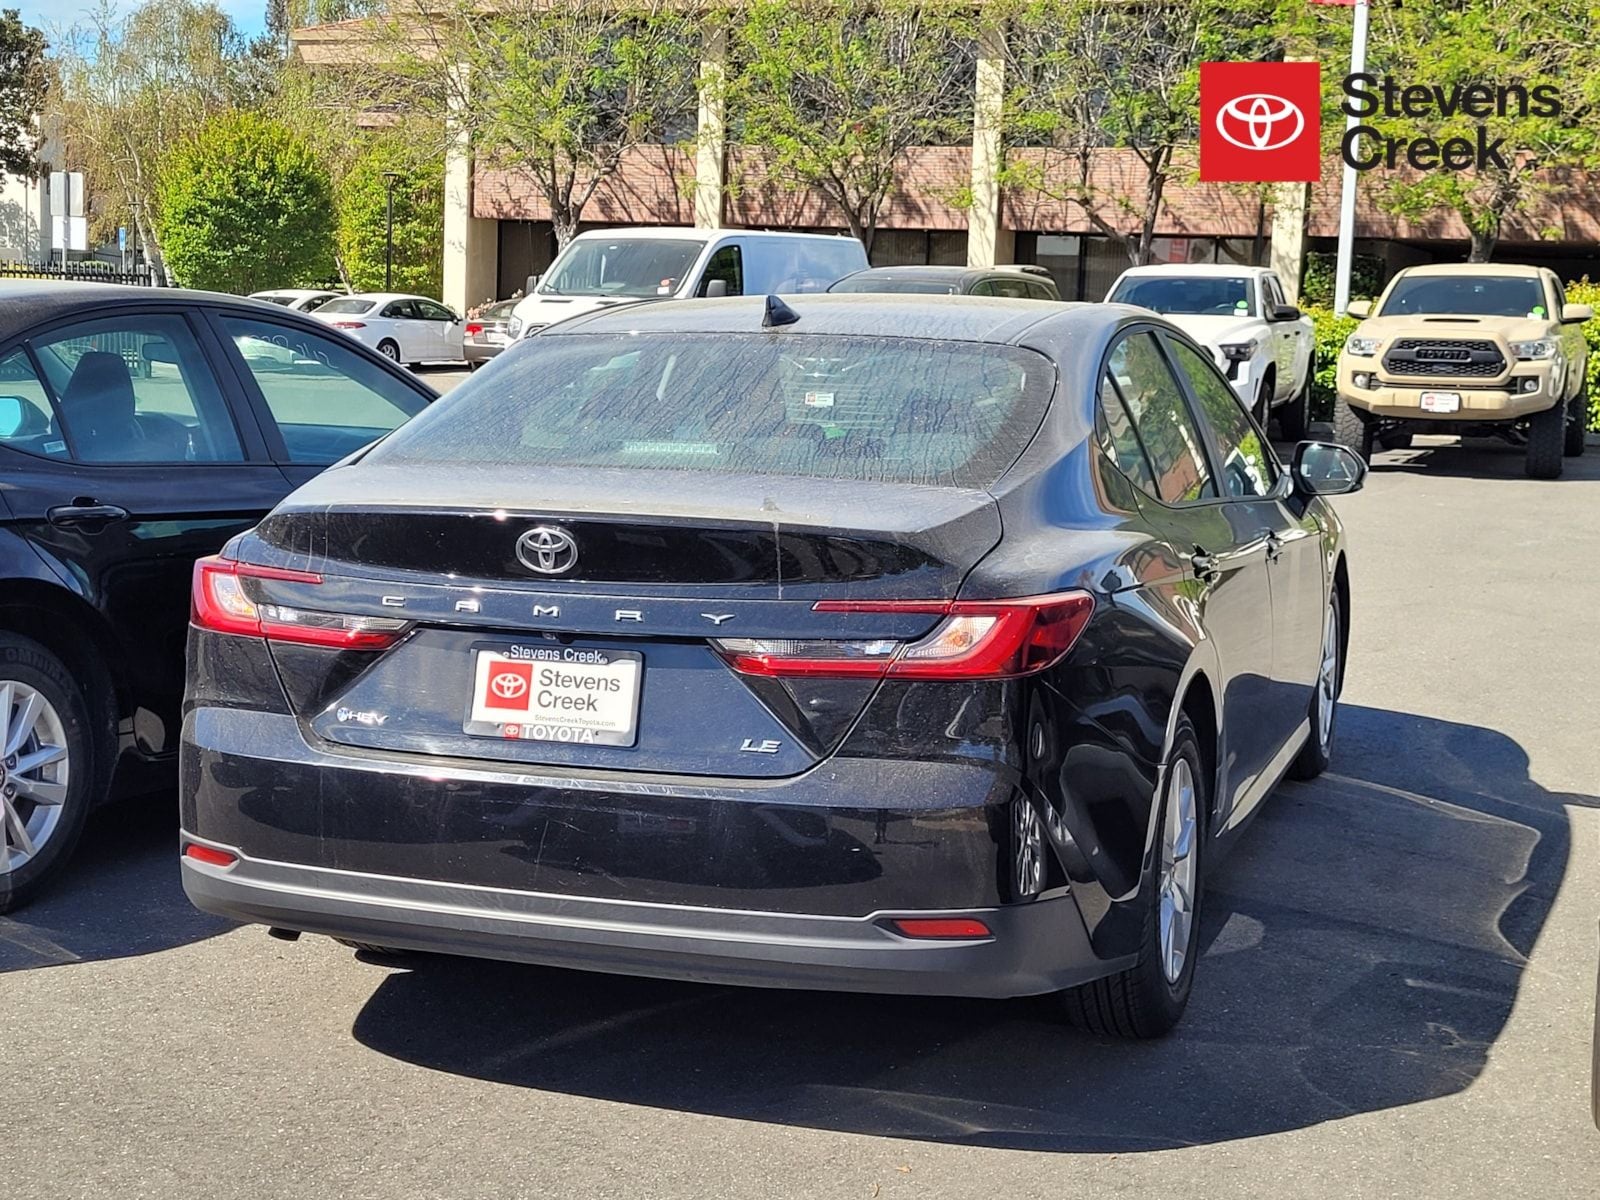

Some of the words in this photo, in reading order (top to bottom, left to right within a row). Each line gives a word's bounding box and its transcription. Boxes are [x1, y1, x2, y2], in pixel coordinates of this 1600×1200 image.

[1418, 349, 1469, 359] TOYOTA
[381, 594, 736, 625] CAMRY
[510, 645, 560, 661] Stevens
[563, 648, 602, 664] Creek
[539, 668, 621, 693] Stevens
[537, 690, 599, 712] Creek
[534, 713, 616, 728] StevensCreekToyota.com
[522, 724, 595, 743] TOYOTA
[740, 738, 782, 754] LE
